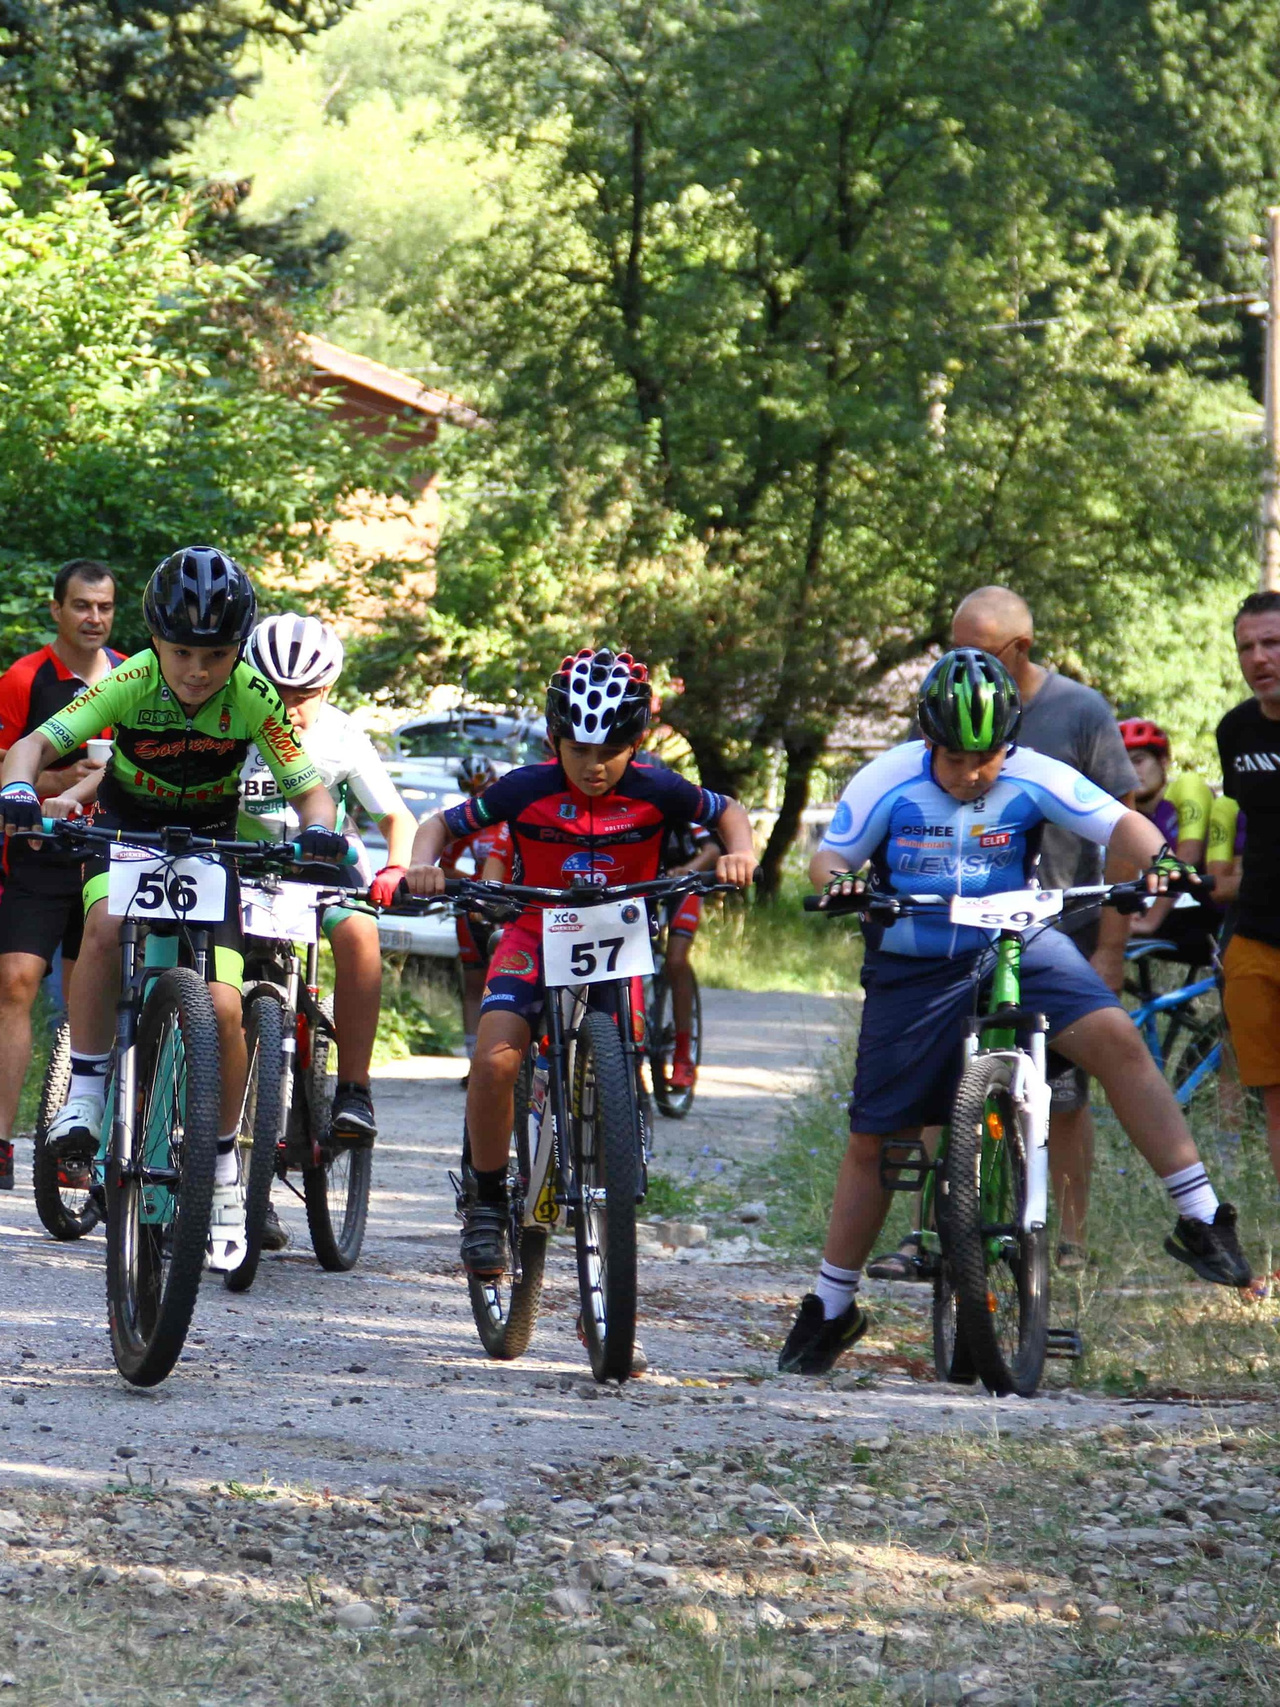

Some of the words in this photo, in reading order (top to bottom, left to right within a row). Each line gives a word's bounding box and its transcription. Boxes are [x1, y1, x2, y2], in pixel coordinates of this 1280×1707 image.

[244, 780, 282, 797] BE
[902, 825, 954, 837] OSHEE
[135, 873, 198, 912] 56
[980, 911, 1036, 926] 59
[570, 937, 625, 977] 57
